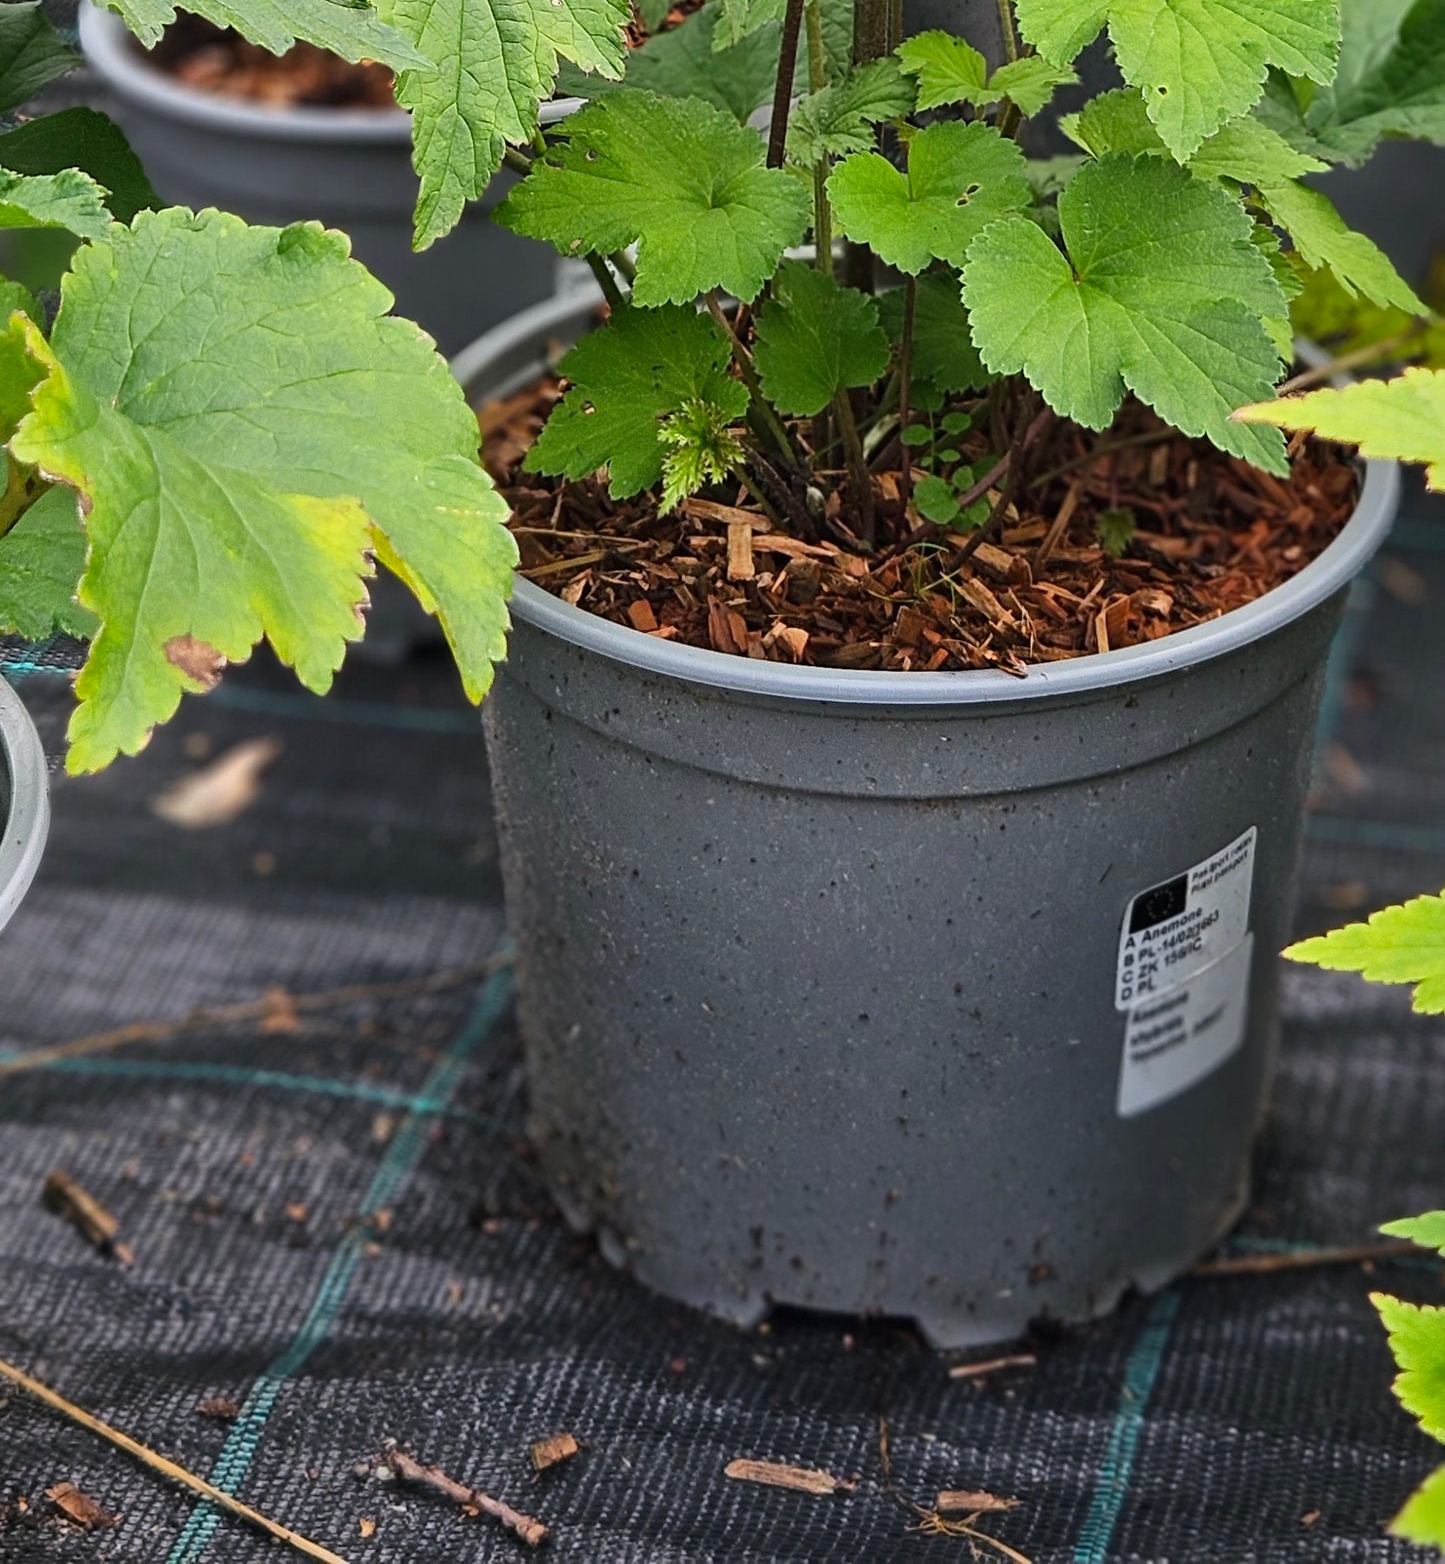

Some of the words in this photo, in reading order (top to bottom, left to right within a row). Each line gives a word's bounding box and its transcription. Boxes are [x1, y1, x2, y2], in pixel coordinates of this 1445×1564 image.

[1124, 936, 1136, 950] A
[1142, 907, 1202, 943] Anemone
[1122, 970, 1134, 984] C
[1137, 959, 1158, 979] ZK
[1123, 953, 1134, 967] B
[1121, 987, 1132, 1001] D
[1137, 976, 1156, 994] PL
